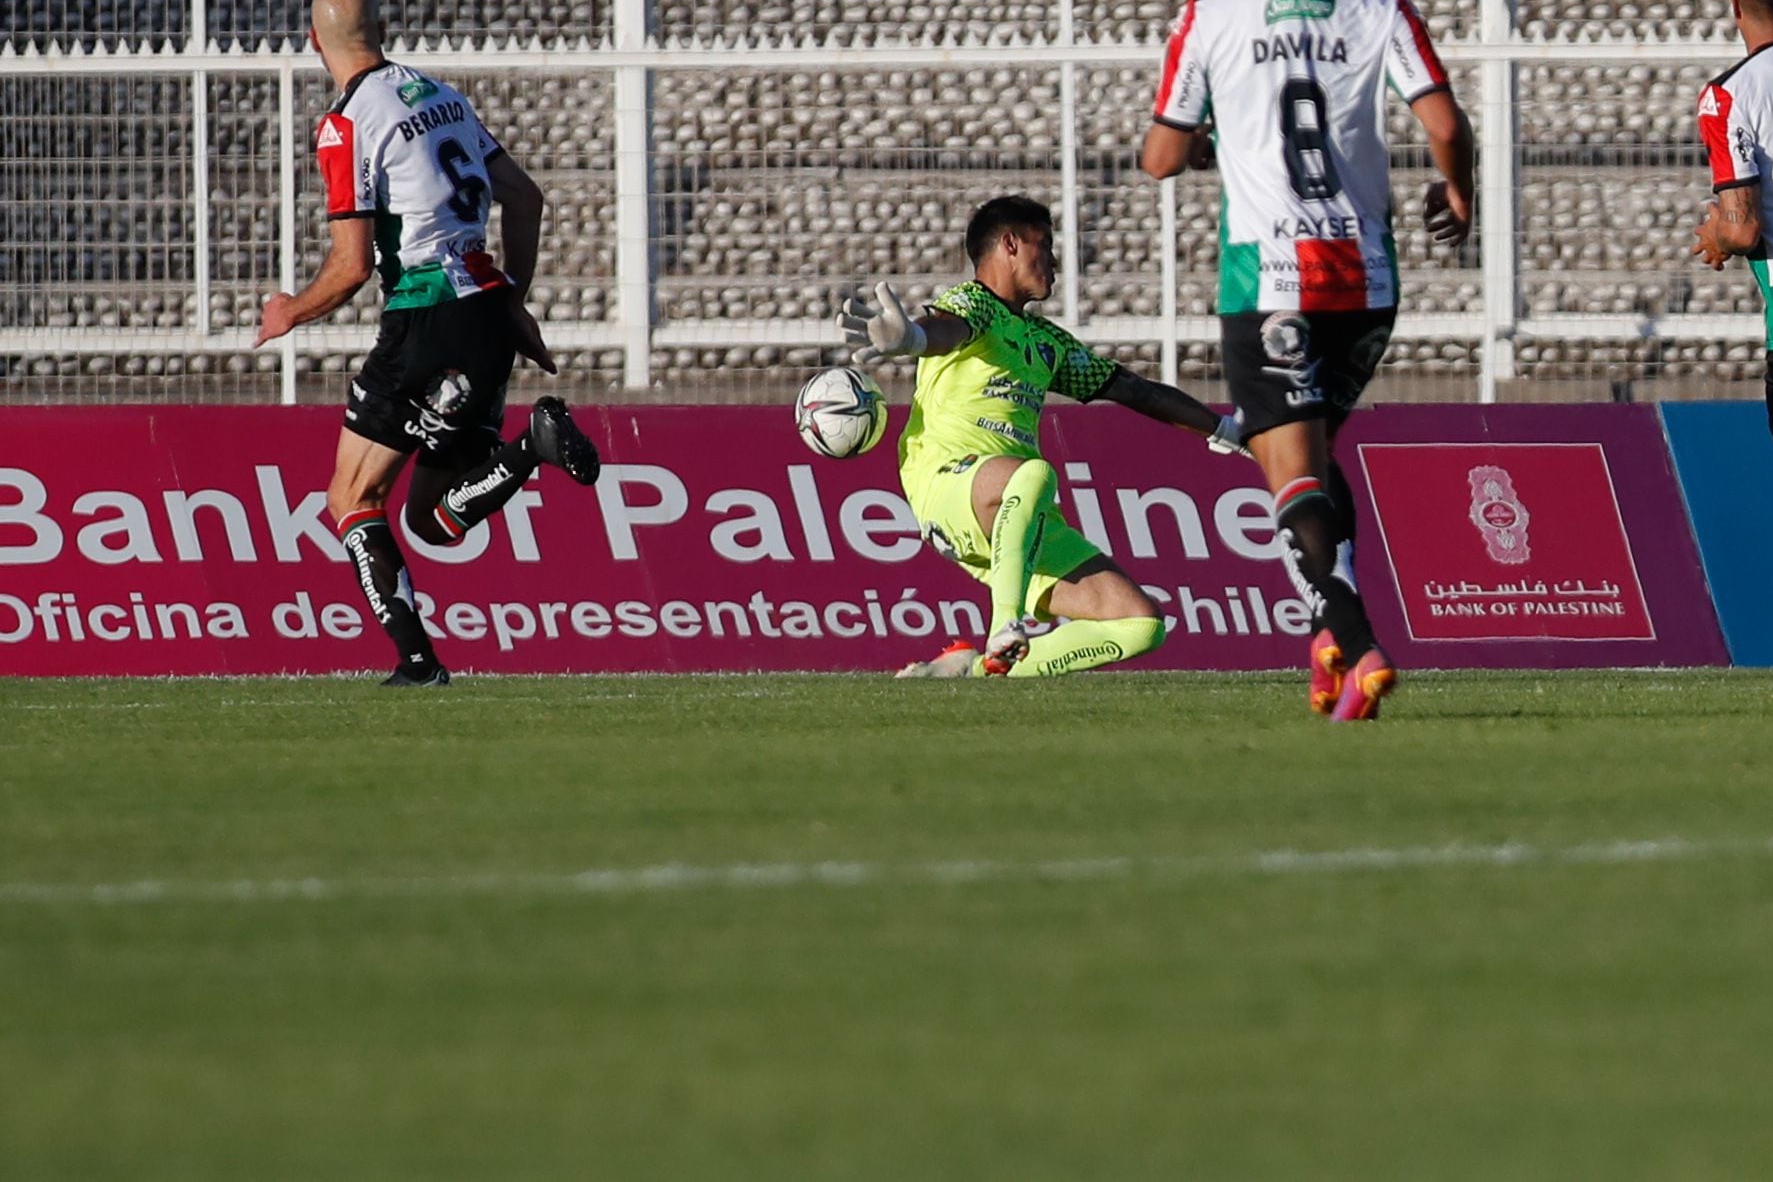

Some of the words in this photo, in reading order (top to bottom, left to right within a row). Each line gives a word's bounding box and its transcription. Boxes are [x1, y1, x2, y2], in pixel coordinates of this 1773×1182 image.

[1253, 33, 1347, 64] DAVILA
[1280, 79, 1343, 200] 8
[437, 136, 492, 223] 6
[403, 420, 440, 451] UAZ
[0, 465, 353, 564] Bank
[448, 463, 508, 513] Continental
[348, 528, 388, 618] Continental
[0, 592, 250, 644] Oficina
[271, 591, 364, 639] de
[408, 587, 986, 651] Representación
[1430, 602, 1487, 617] BANK
[1490, 601, 1519, 616] OF
[1523, 601, 1626, 616] PALESTINE
[1046, 640, 1124, 675] Continental
